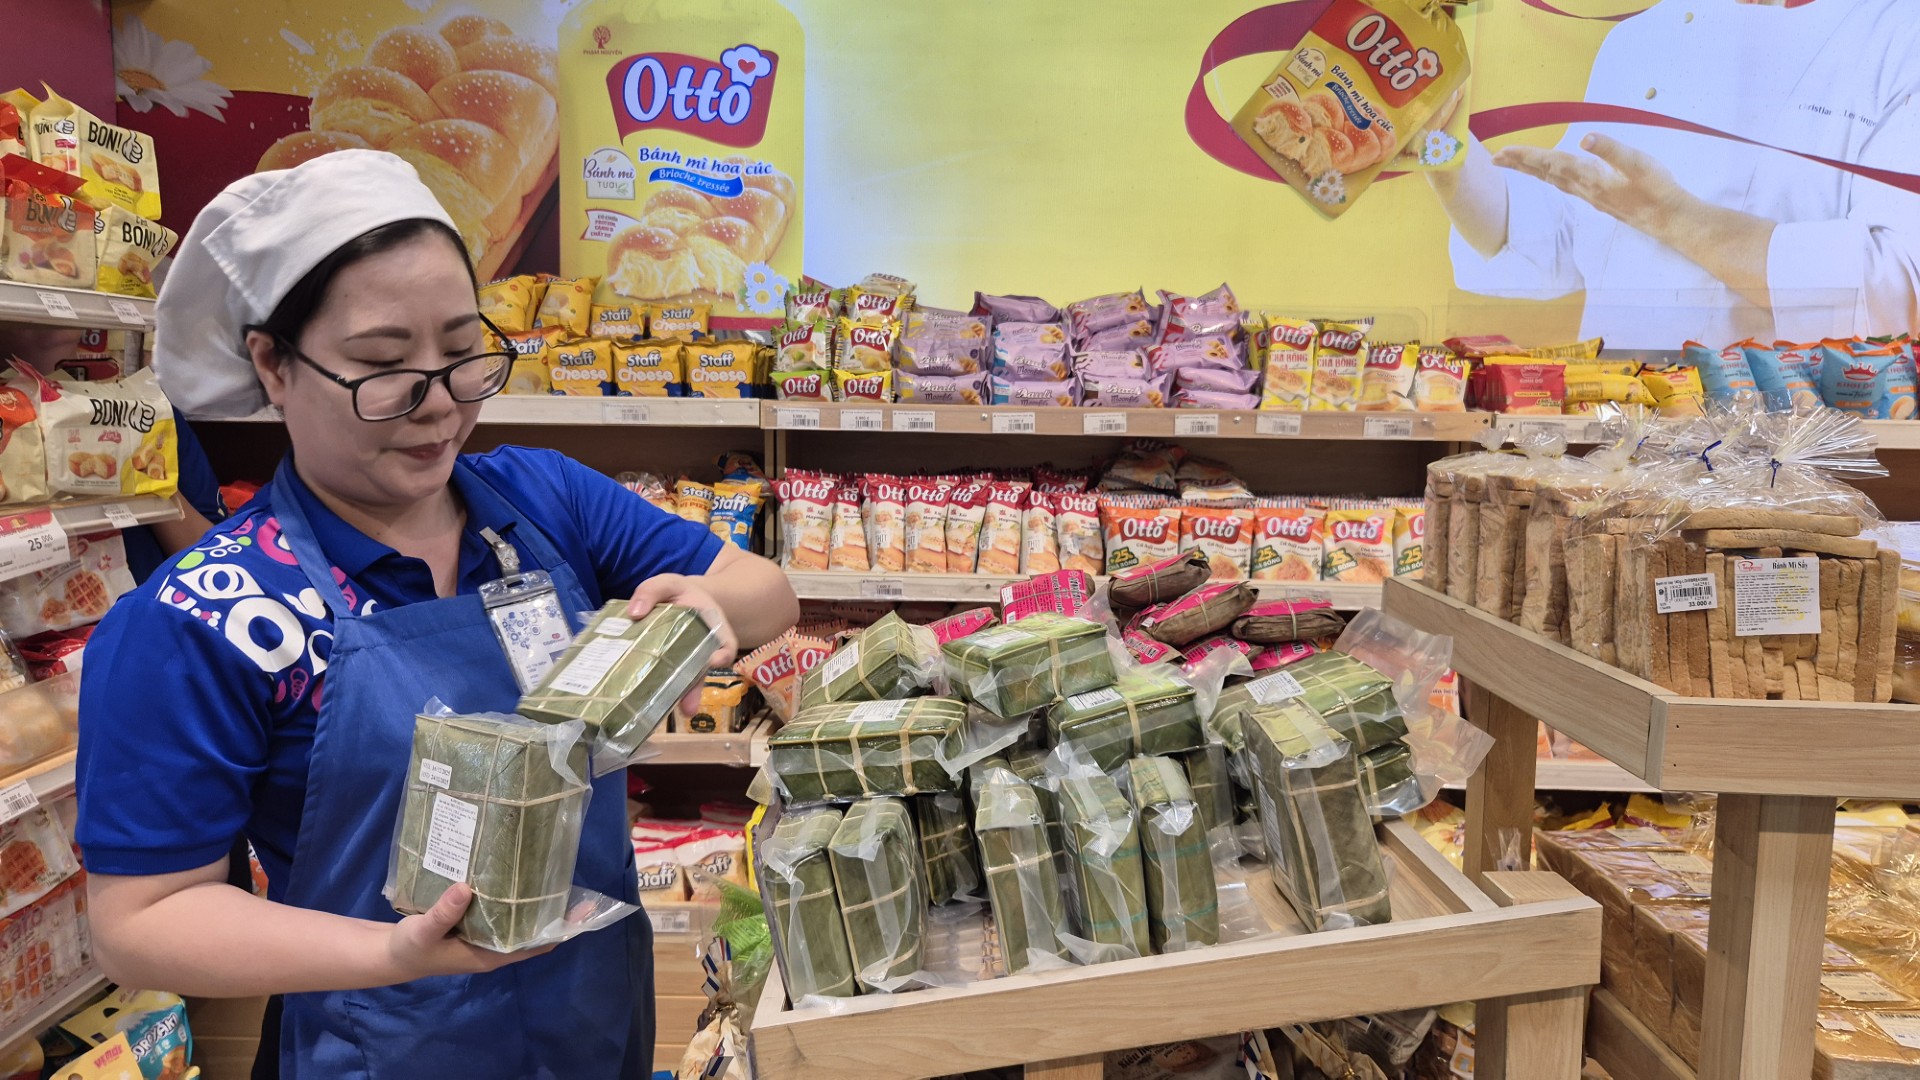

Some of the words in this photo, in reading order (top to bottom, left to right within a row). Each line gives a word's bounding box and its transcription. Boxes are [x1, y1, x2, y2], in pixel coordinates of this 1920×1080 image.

[1346, 14, 1418, 90] Otto
[623, 56, 752, 126] Otto
[1330, 64, 1354, 89] Bánh
[1350, 88, 1364, 103] mì
[1360, 101, 1378, 120] hoa
[1376, 117, 1394, 132] cúc
[88, 121, 123, 154] BON!
[583, 158, 617, 179] Bánh
[617, 167, 636, 180] mì
[639, 148, 682, 165] Bánh
[685, 156, 712, 172] mì
[711, 160, 741, 176] hoa
[744, 160, 773, 176] cúc
[658, 169, 697, 184] Brioche
[697, 179, 731, 193] tressée
[600, 307, 632, 322] Staff
[661, 306, 694, 320] Staff
[591, 323, 641, 336] Cheese
[652, 319, 702, 332] Cheese
[783, 328, 809, 346] Otto
[1273, 325, 1308, 345] Otto
[1322, 331, 1357, 351] Otto
[500, 336, 545, 355] Saff
[559, 350, 596, 367] Staff
[627, 350, 662, 368] Staff
[699, 350, 735, 368] Staff
[1368, 347, 1397, 364] tto
[551, 367, 609, 382] Cheese
[617, 369, 675, 383] Cheese
[690, 369, 747, 383] Cheese
[784, 377, 817, 394] Otto
[846, 378, 879, 395] Otto
[90, 398, 127, 427] BON!
[792, 480, 830, 500] Otto
[878, 483, 905, 501] Ott
[909, 485, 945, 502] Otto
[952, 487, 973, 503] tto
[712, 493, 750, 512] Staff
[1060, 496, 1097, 513] Otto
[1123, 517, 1163, 539] Otto
[1194, 517, 1236, 539] Otto
[1266, 516, 1307, 537] Otto
[1335, 521, 1379, 540] Otto
[27, 537, 43, 552] 25
[1772, 560, 1787, 570] Bánh
[1788, 561, 1797, 569] Mì
[1688, 600, 1708, 608] 33.000
[638, 866, 677, 888] Staff
[130, 1012, 179, 1063] ORAYAKI
